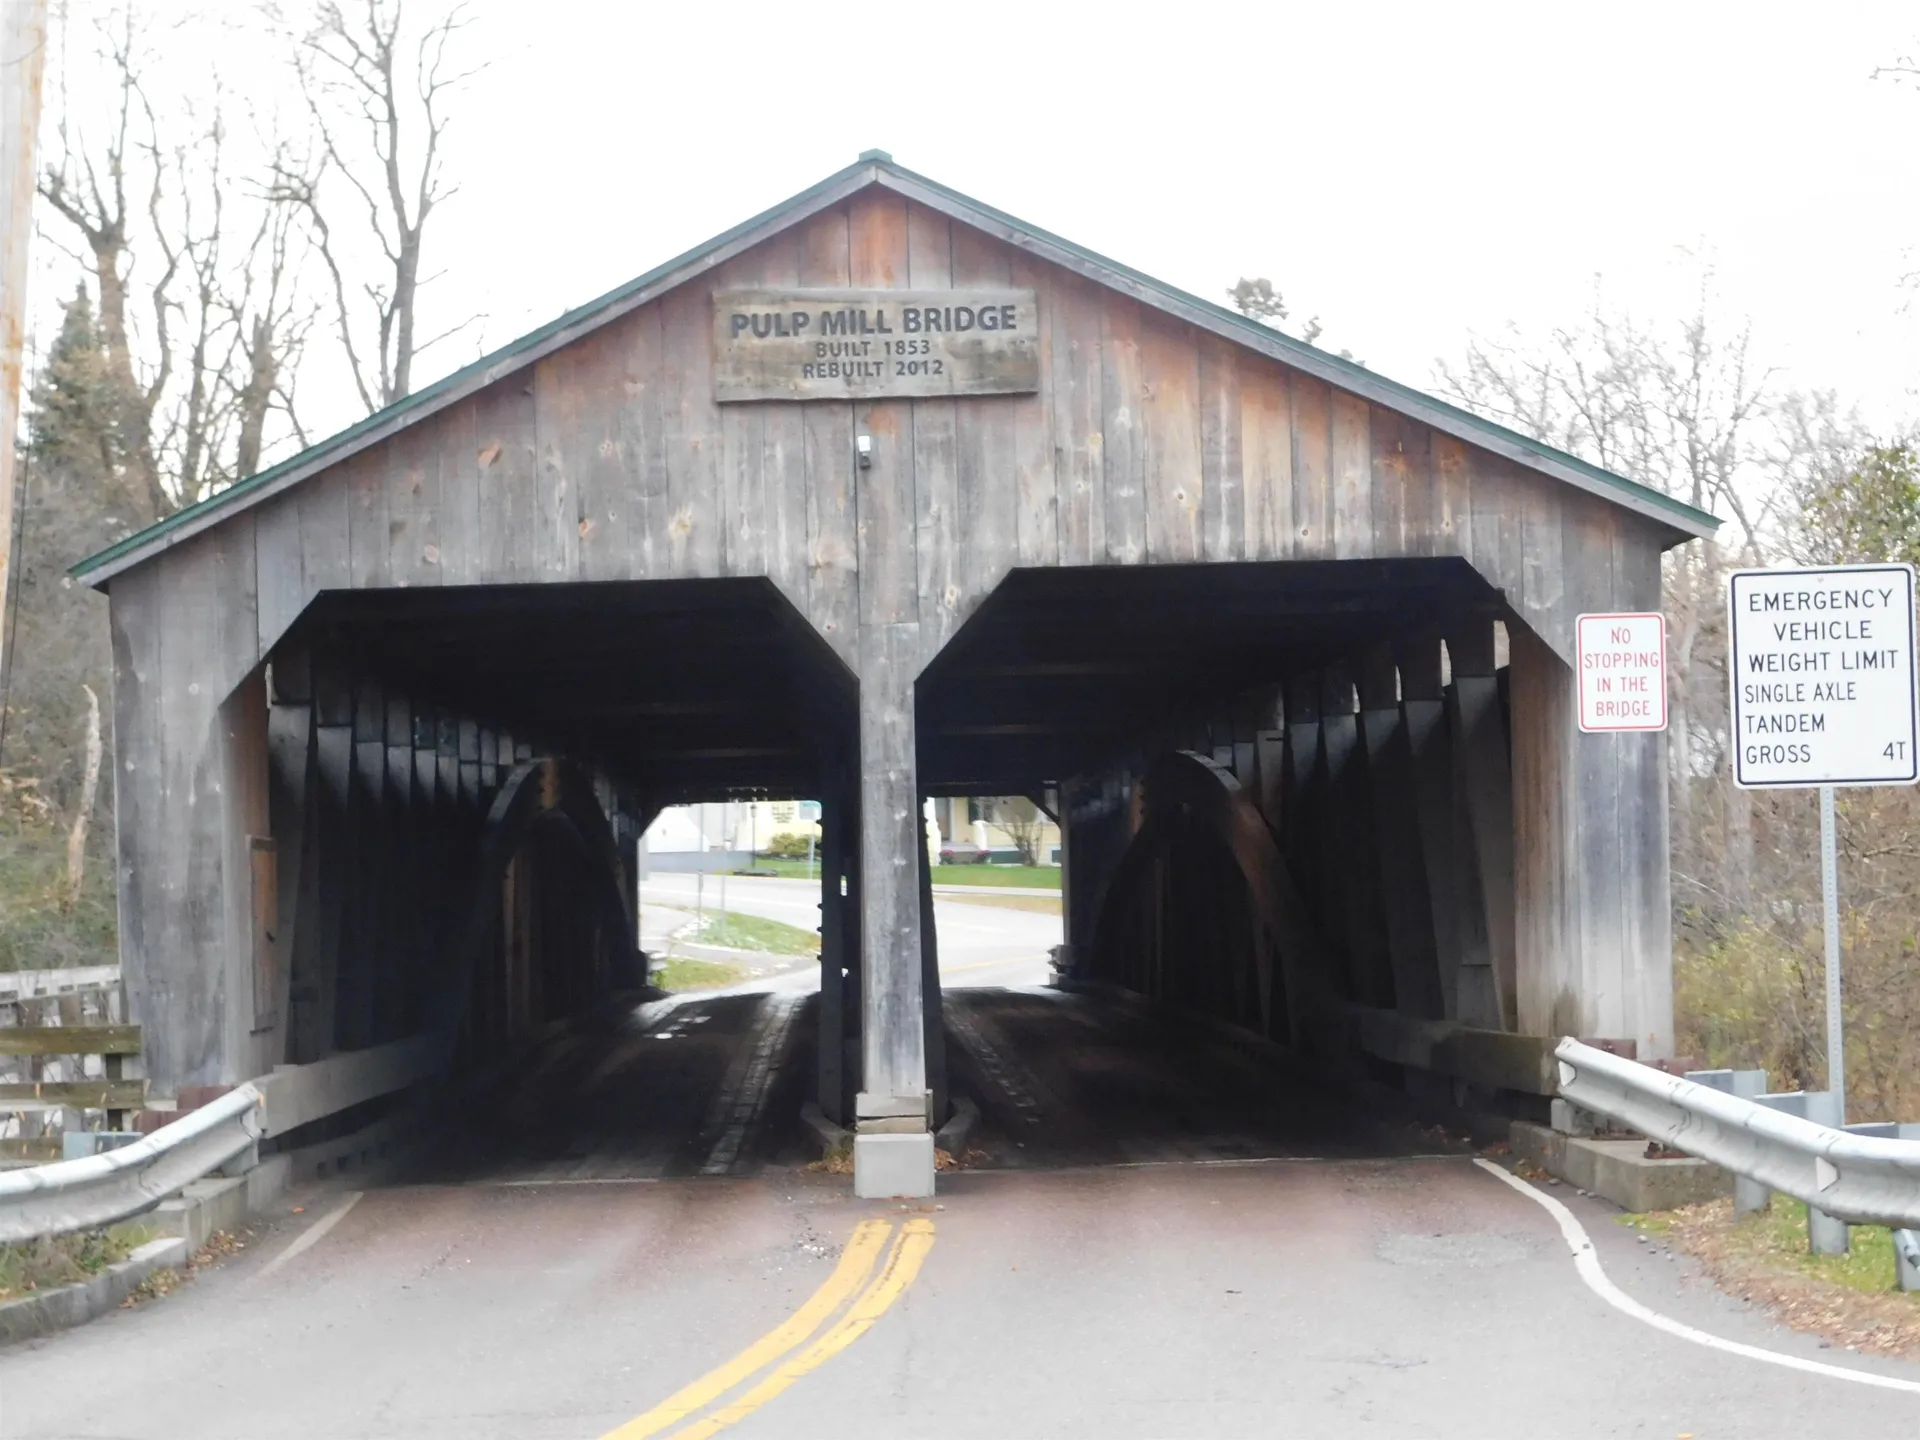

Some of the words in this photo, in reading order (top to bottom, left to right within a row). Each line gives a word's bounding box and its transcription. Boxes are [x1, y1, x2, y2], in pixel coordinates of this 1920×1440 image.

[731, 312, 810, 338] PULP
[821, 309, 893, 336] MILL
[903, 305, 1017, 333] BRIDGE
[816, 341, 871, 358] BUILT
[884, 340, 930, 355] 1853
[803, 361, 884, 379] REBUILT
[895, 360, 943, 376] 2012
[1749, 589, 1893, 611] EMERGENCY
[1611, 627, 1631, 644] NO
[1774, 620, 1872, 641] VEHICLE
[1584, 652, 1659, 669] STOPPING
[1749, 652, 1830, 672] WEIGHT
[1842, 650, 1898, 670] LIMIT
[1597, 677, 1611, 692] IN
[1620, 676, 1648, 692] THE
[1745, 683, 1805, 703] SINGLE
[1813, 682, 1857, 701] AXLE
[1596, 700, 1651, 718] BRIDGE
[1745, 713, 1825, 734] TANDEM
[1746, 744, 1811, 764] GROSS
[1883, 741, 1906, 760] 4T
